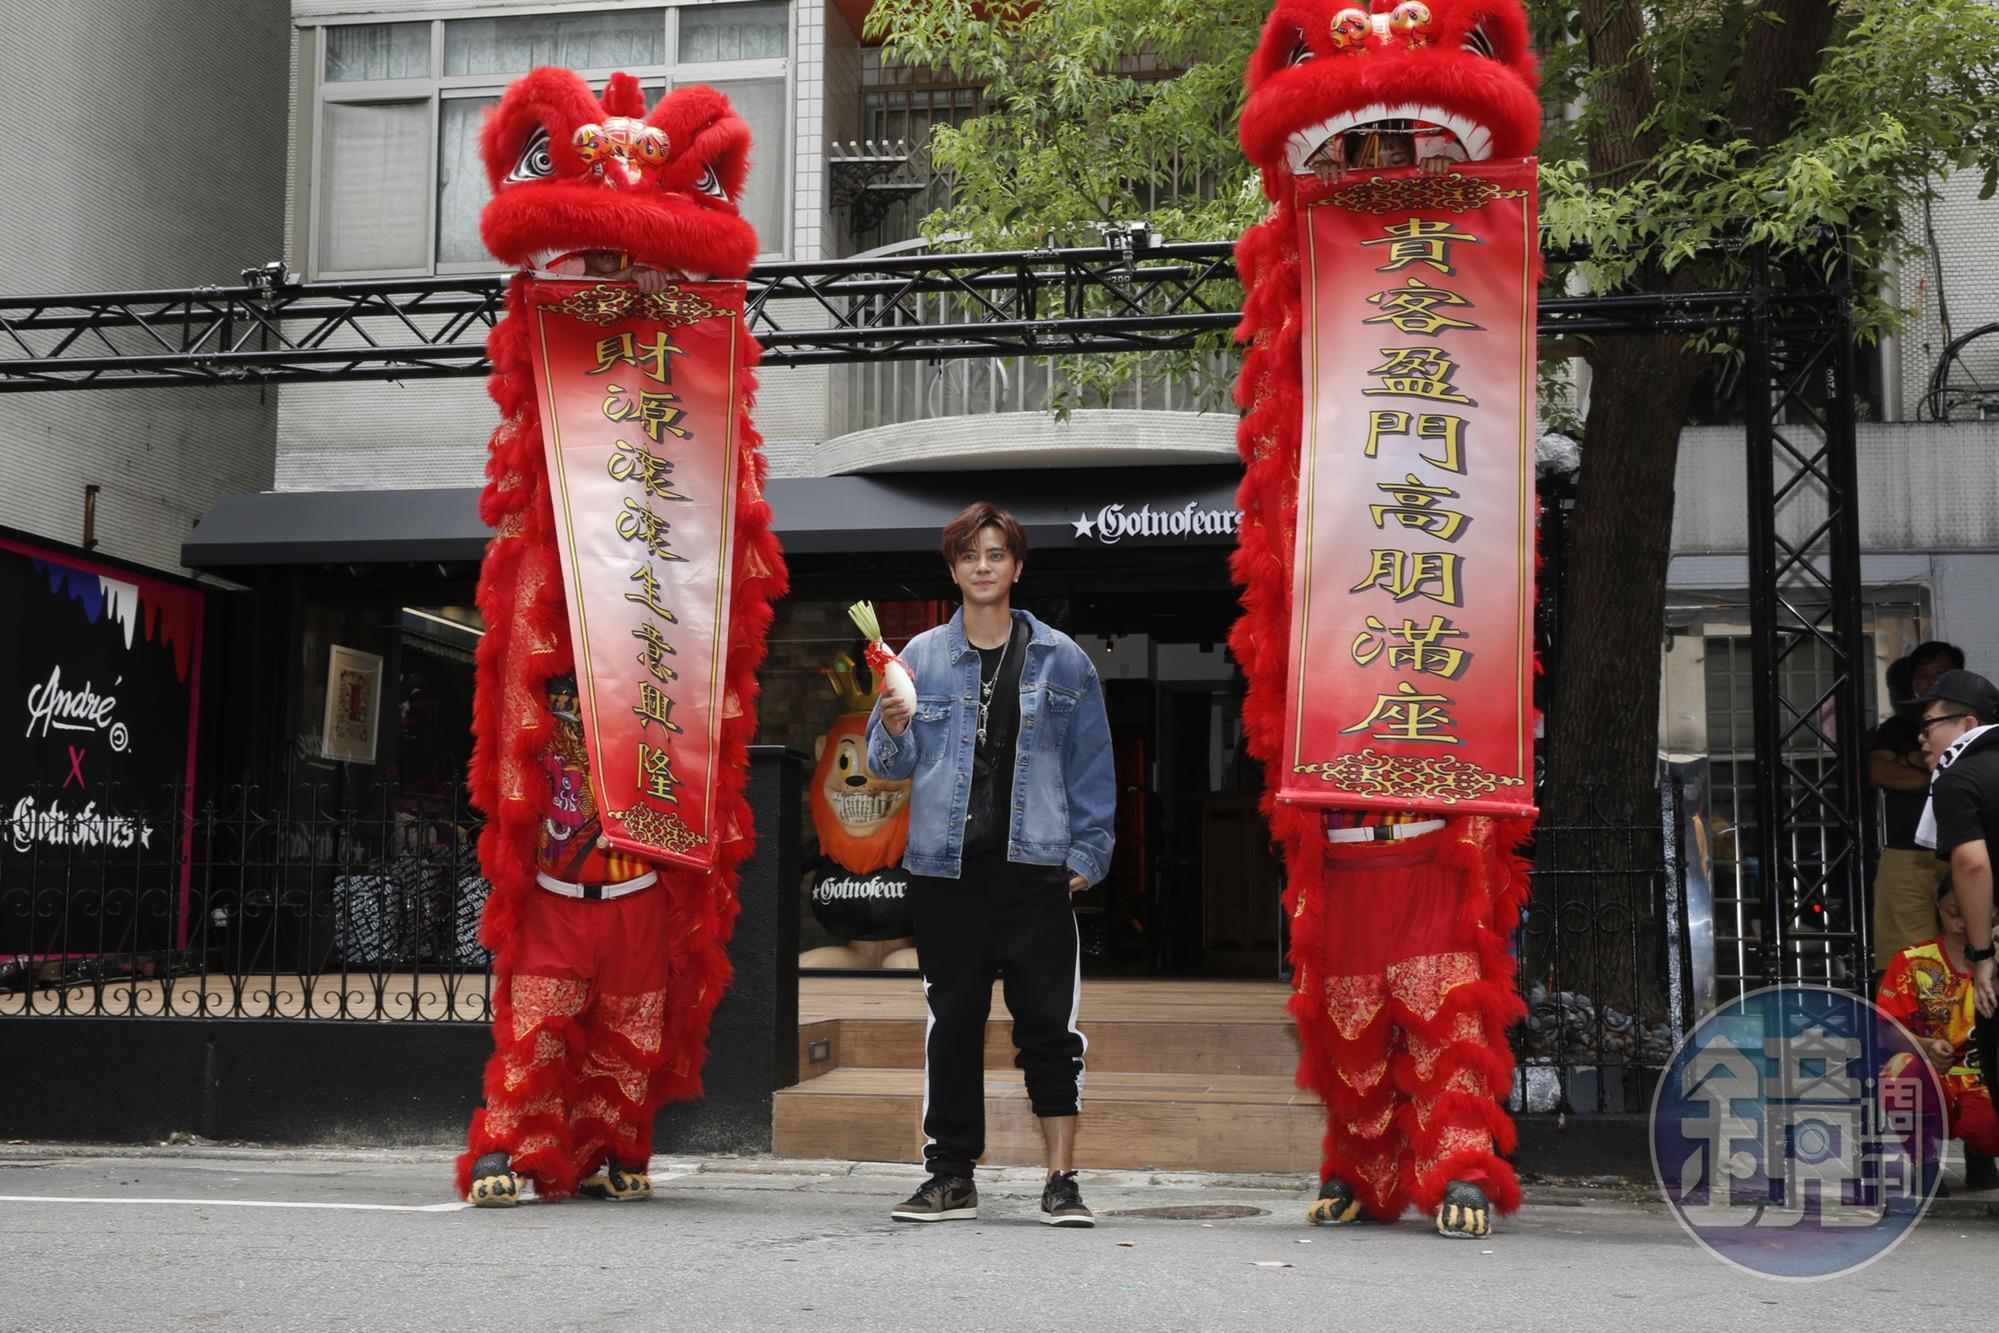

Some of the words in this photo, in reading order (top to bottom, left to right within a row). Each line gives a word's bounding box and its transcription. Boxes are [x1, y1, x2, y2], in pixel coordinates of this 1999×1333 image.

[586, 331, 694, 808] 財源滾滾生意興隆
[1339, 218, 1487, 745] 貴客盈門高朋滿座
[820, 876, 907, 905] Gotnofear
